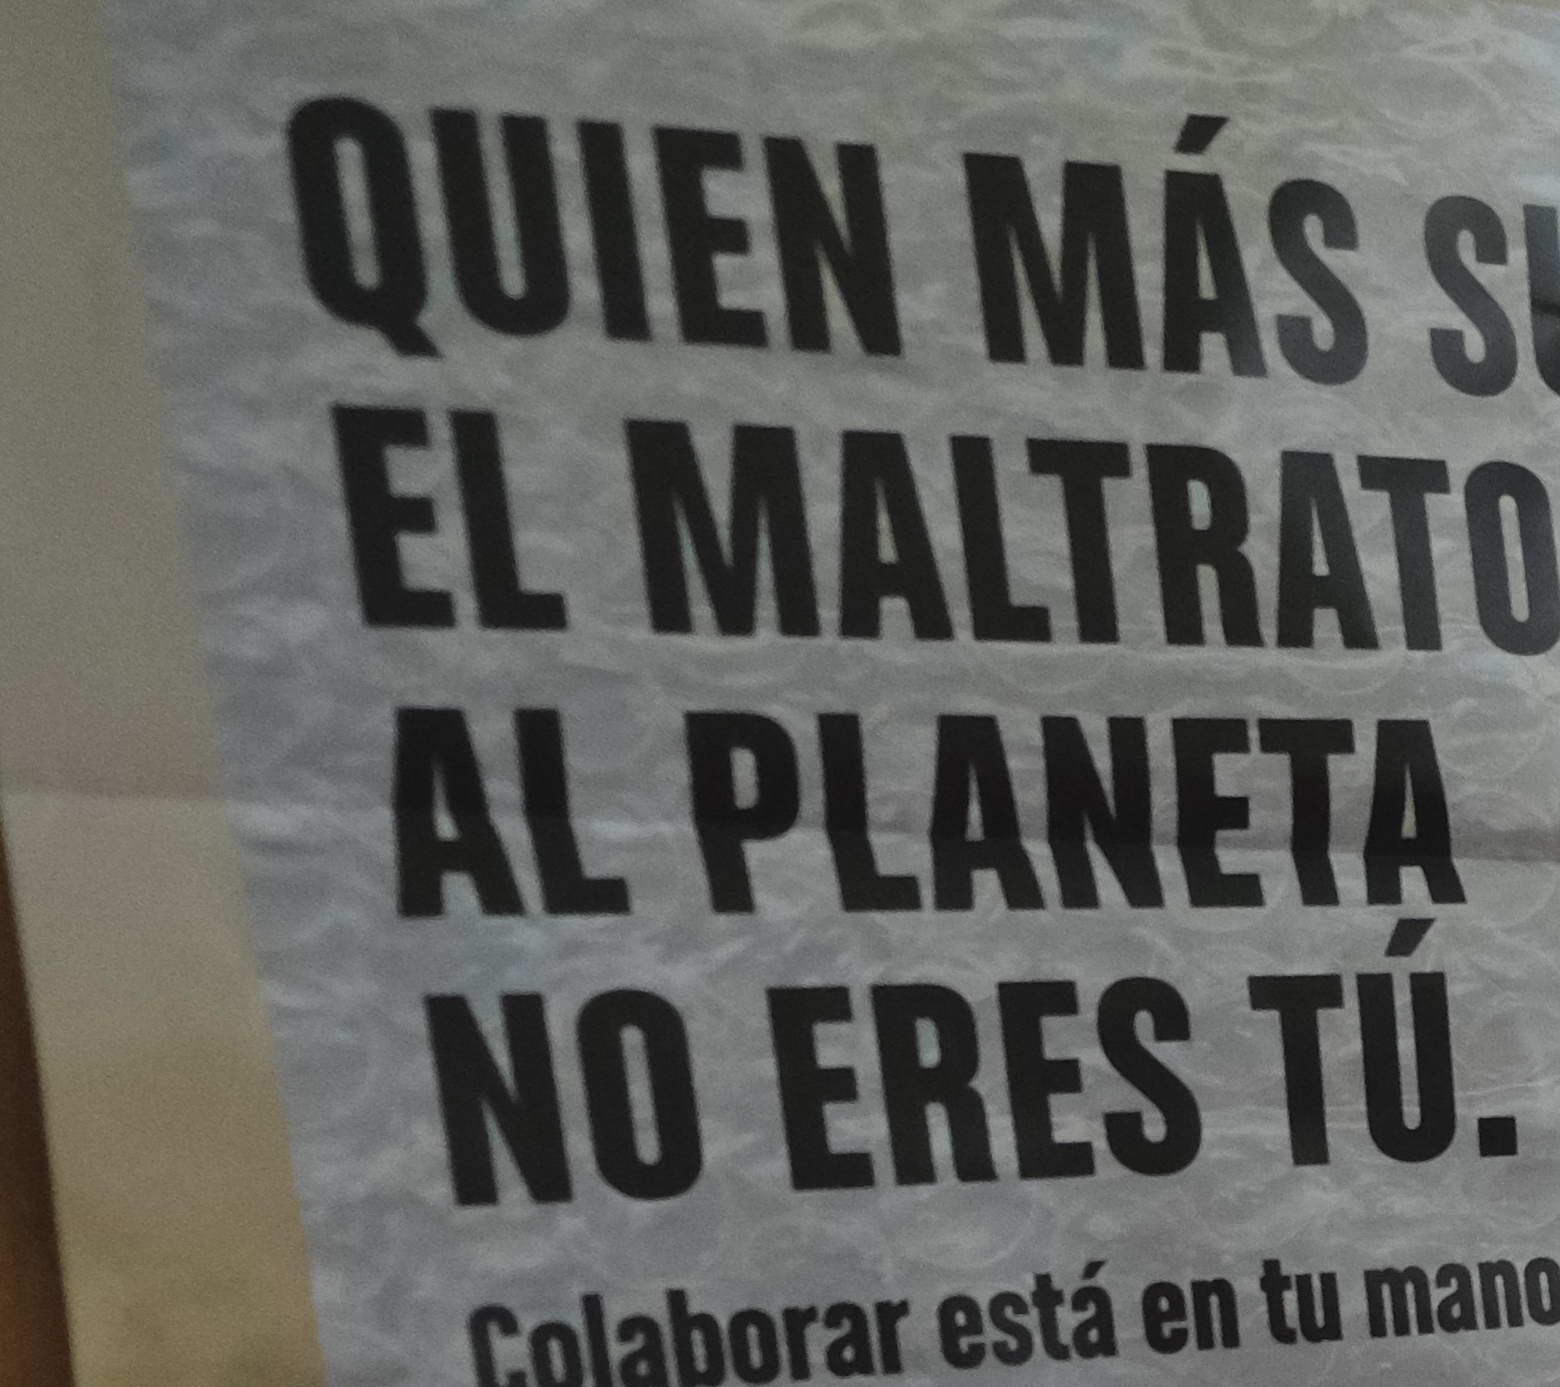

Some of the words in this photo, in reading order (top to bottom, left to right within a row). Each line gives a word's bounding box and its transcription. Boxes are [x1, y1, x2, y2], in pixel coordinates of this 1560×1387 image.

[286, 96, 902, 358] QUIEN
[962, 114, 1366, 383] MÁS
[331, 404, 567, 630] EL
[623, 418, 1560, 654] MALTRATO
[391, 707, 630, 919] AL
[684, 711, 1465, 911] PLANETA
[423, 989, 702, 1206] NO
[766, 977, 1201, 1191] ERES
[1248, 918, 1517, 1166] TÚ.
[937, 1260, 1118, 1370] está
[1142, 1278, 1240, 1354] en
[1260, 1259, 1342, 1345] tu
